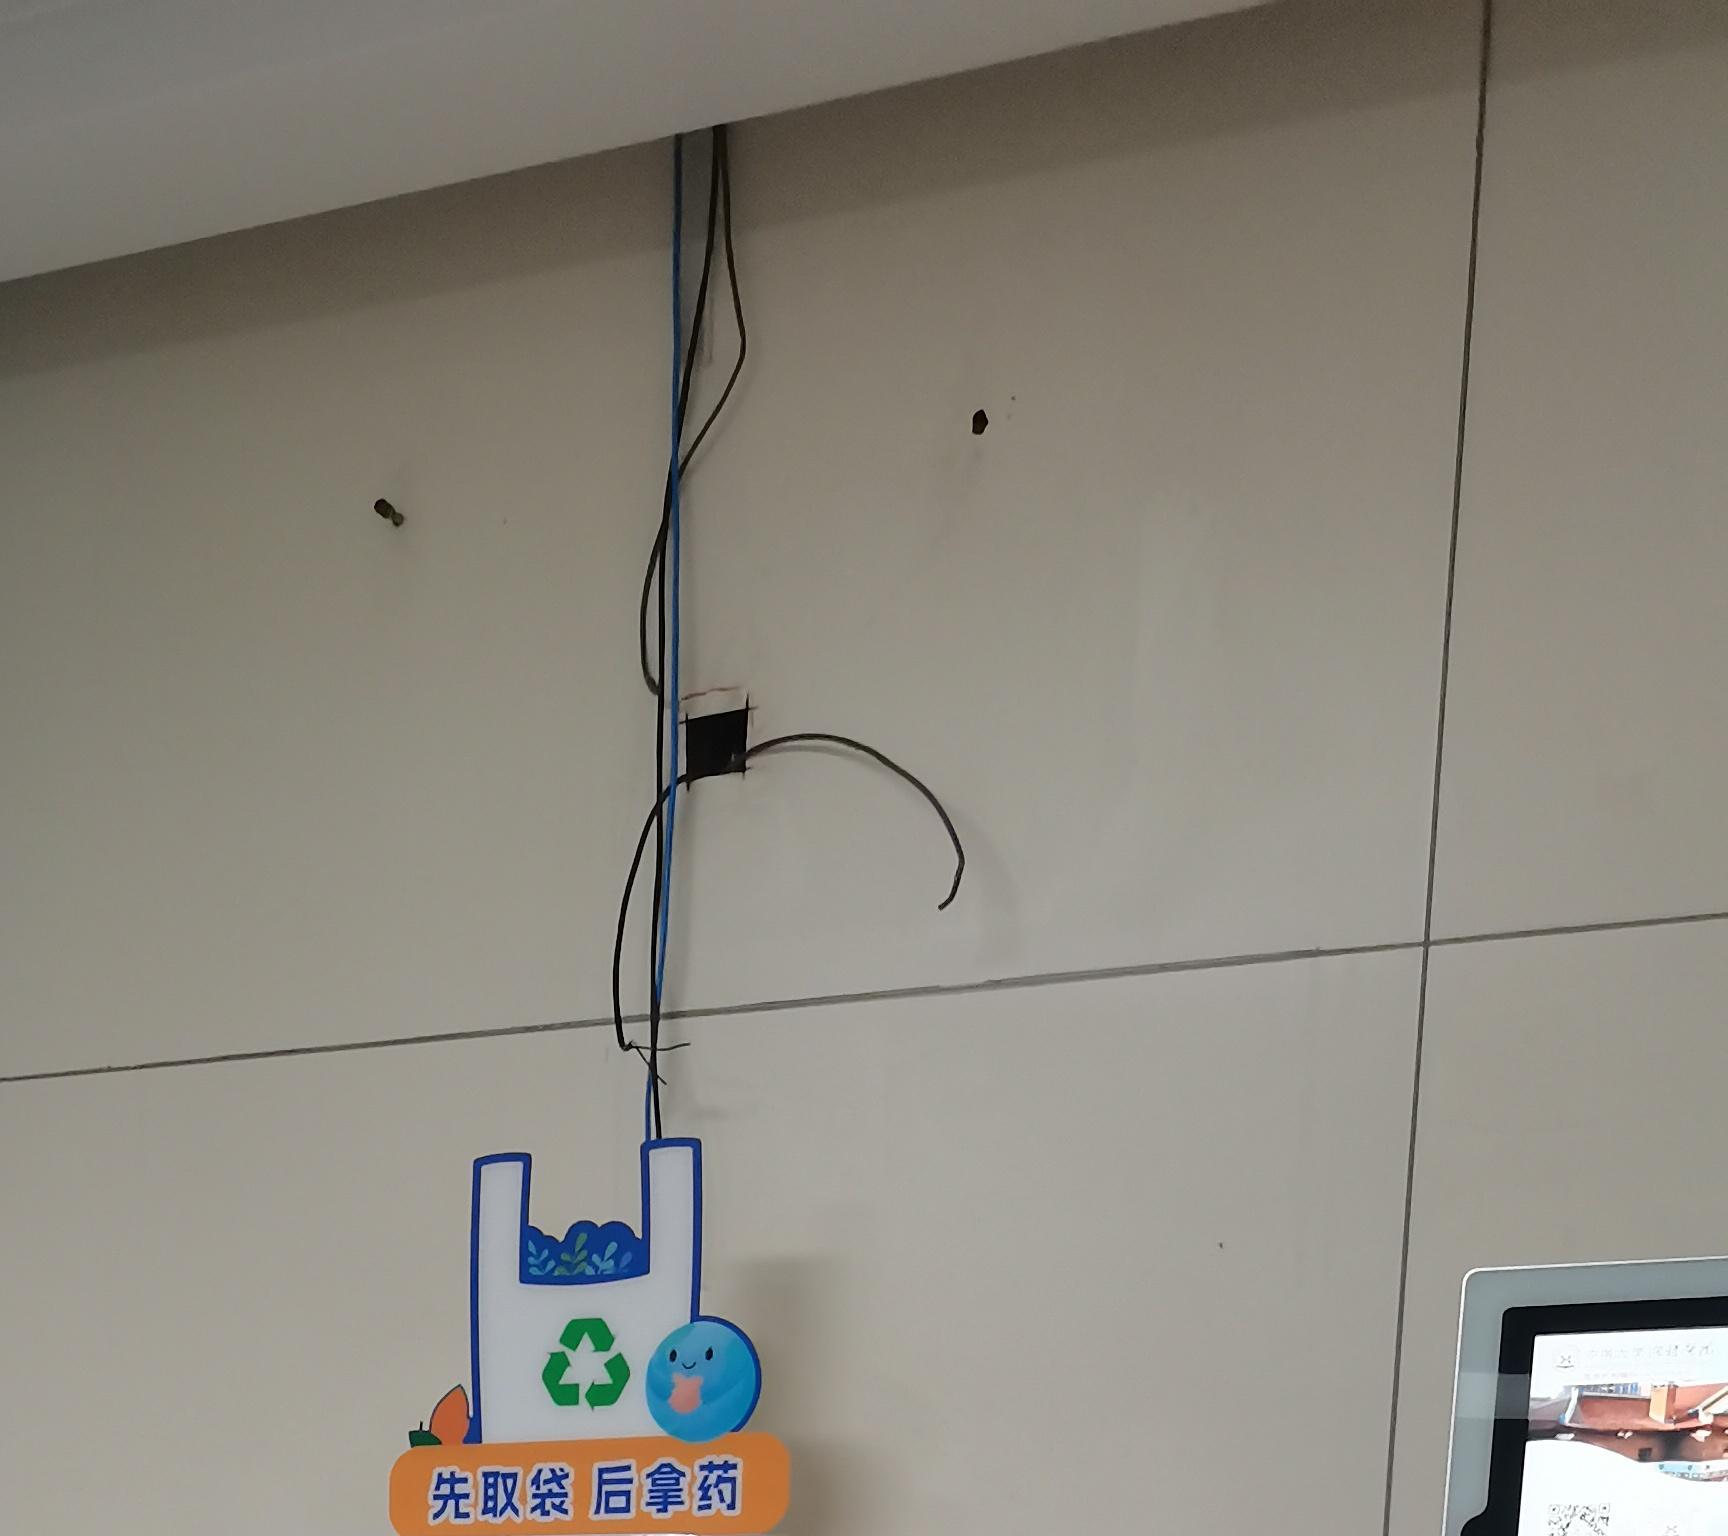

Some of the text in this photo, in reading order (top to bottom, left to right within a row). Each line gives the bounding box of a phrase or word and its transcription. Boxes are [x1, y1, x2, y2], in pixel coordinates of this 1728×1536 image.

[429, 1459, 741, 1522] 先取袋 后拿药
